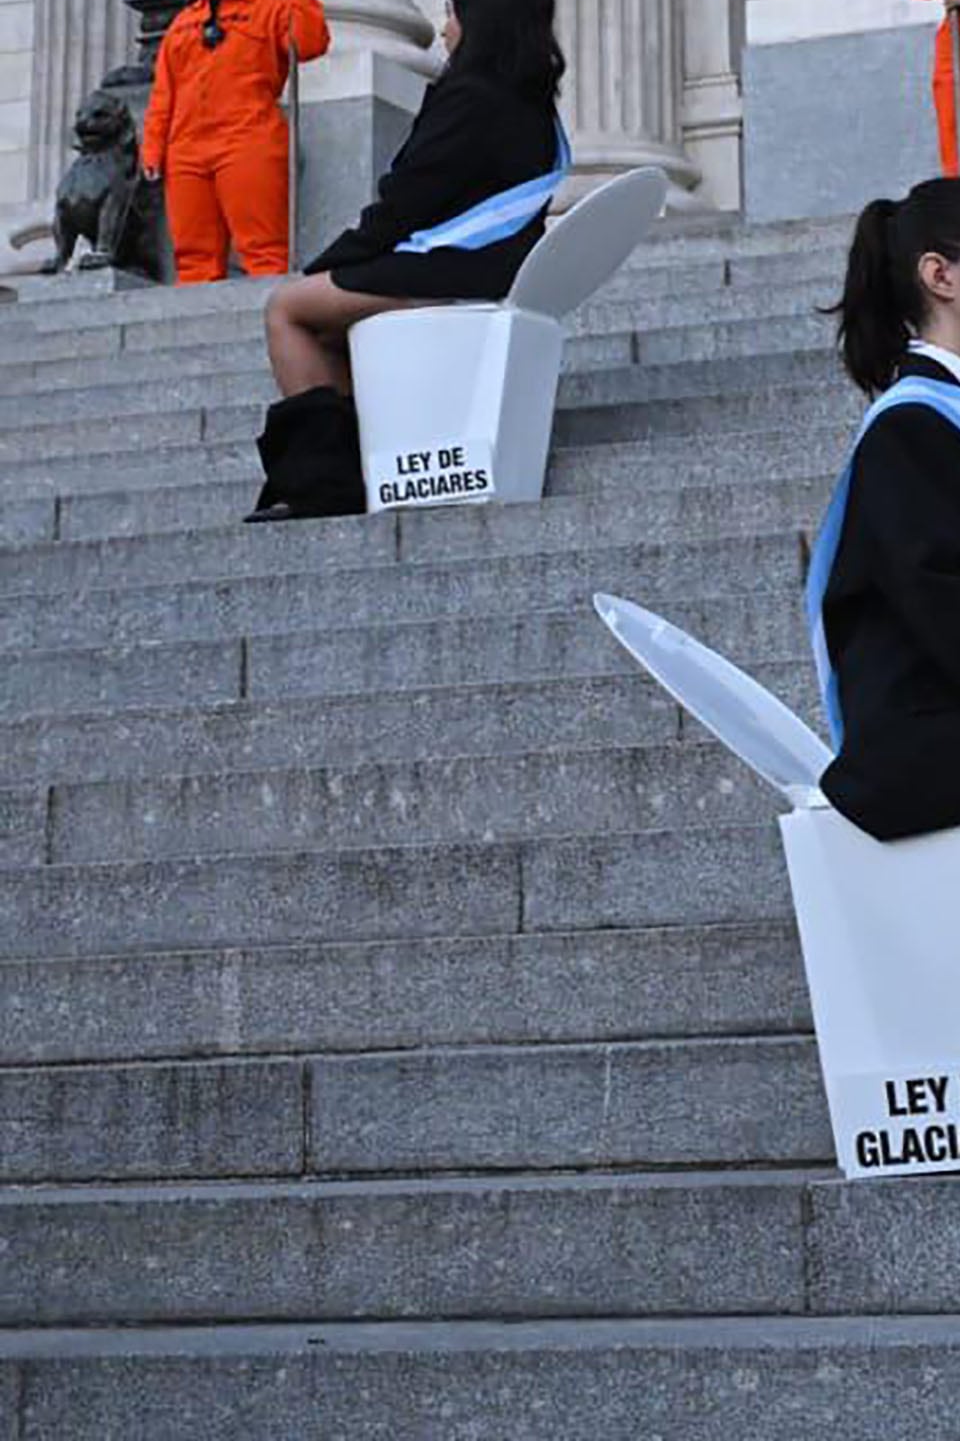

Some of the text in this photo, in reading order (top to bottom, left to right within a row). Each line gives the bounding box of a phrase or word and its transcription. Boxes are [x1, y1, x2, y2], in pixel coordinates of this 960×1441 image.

[396, 447, 464, 475] LEY DE
[379, 469, 488, 504] GLACIARES
[885, 1076, 949, 1117] LEY
